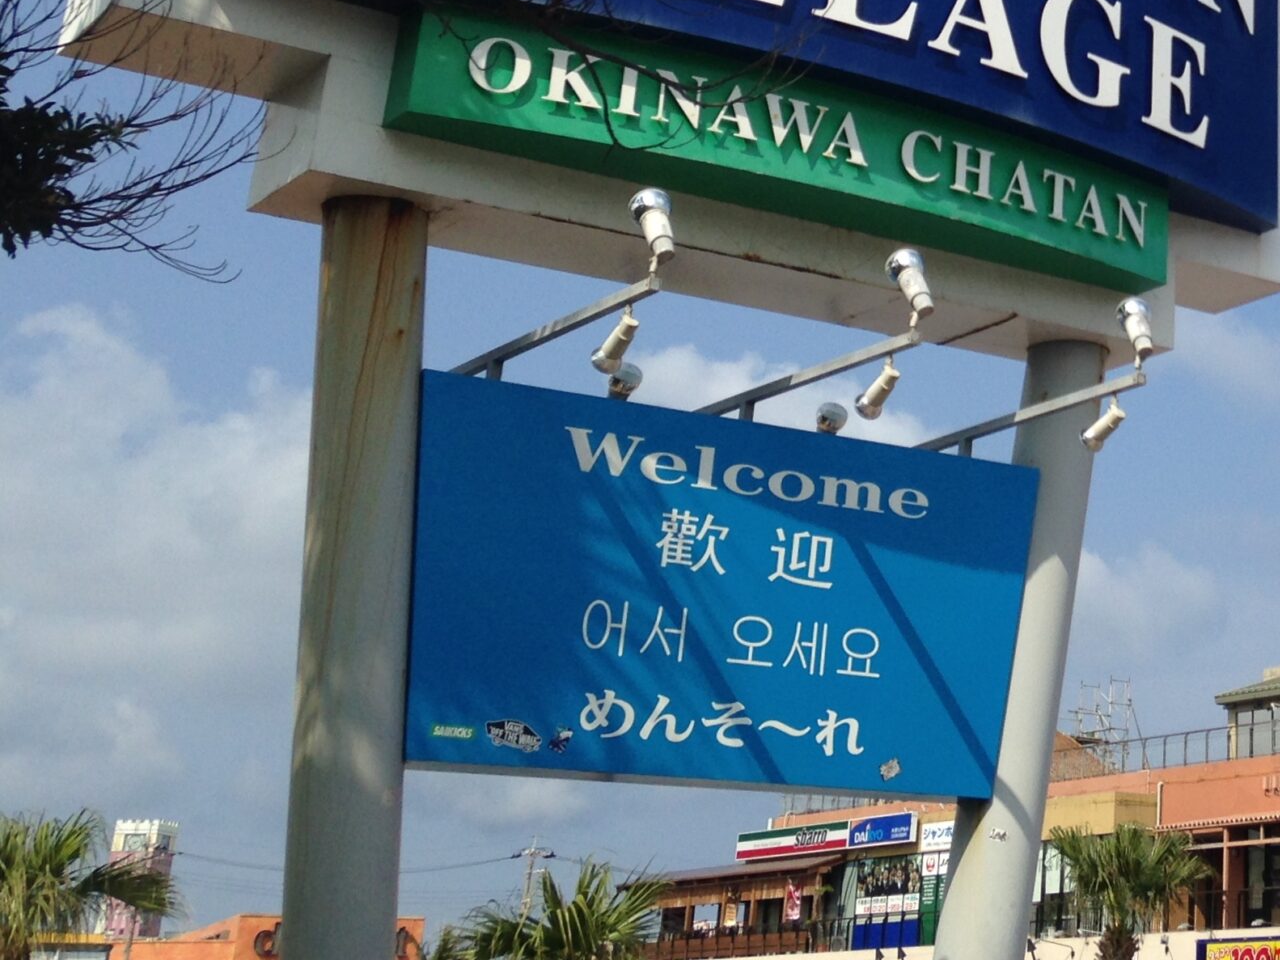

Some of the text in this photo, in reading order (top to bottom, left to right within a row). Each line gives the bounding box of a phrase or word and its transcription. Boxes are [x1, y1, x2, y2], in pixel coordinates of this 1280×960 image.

[468, 36, 1148, 248] OKINAWA CHATAN
[565, 426, 929, 520] Welcome
[582, 598, 881, 678] 어서 오세요
[794, 827, 829, 848] sbarro
